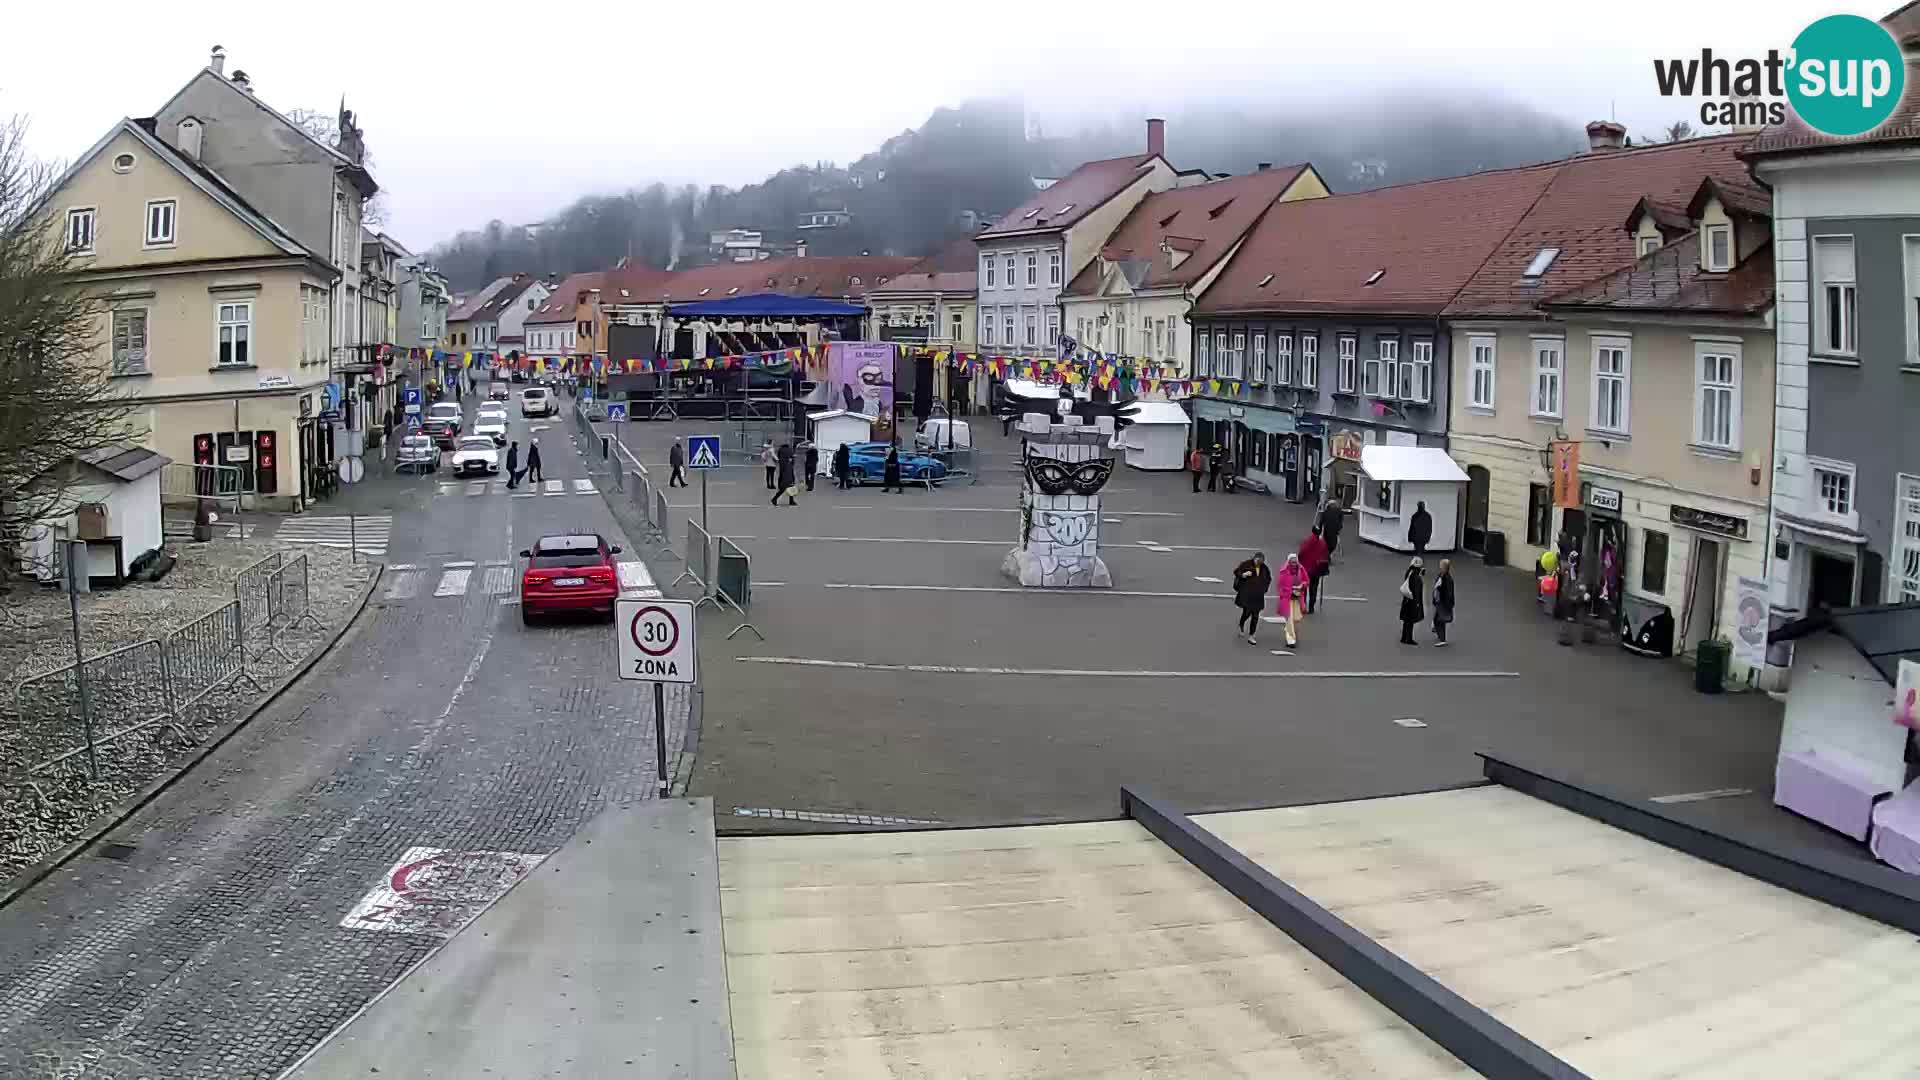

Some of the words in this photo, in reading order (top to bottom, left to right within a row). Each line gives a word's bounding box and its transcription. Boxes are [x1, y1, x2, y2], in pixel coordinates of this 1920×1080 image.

[408, 391, 417, 402] P
[1049, 516, 1087, 546] 200
[643, 622, 668, 643] 30
[634, 659, 678, 676] ZONA
